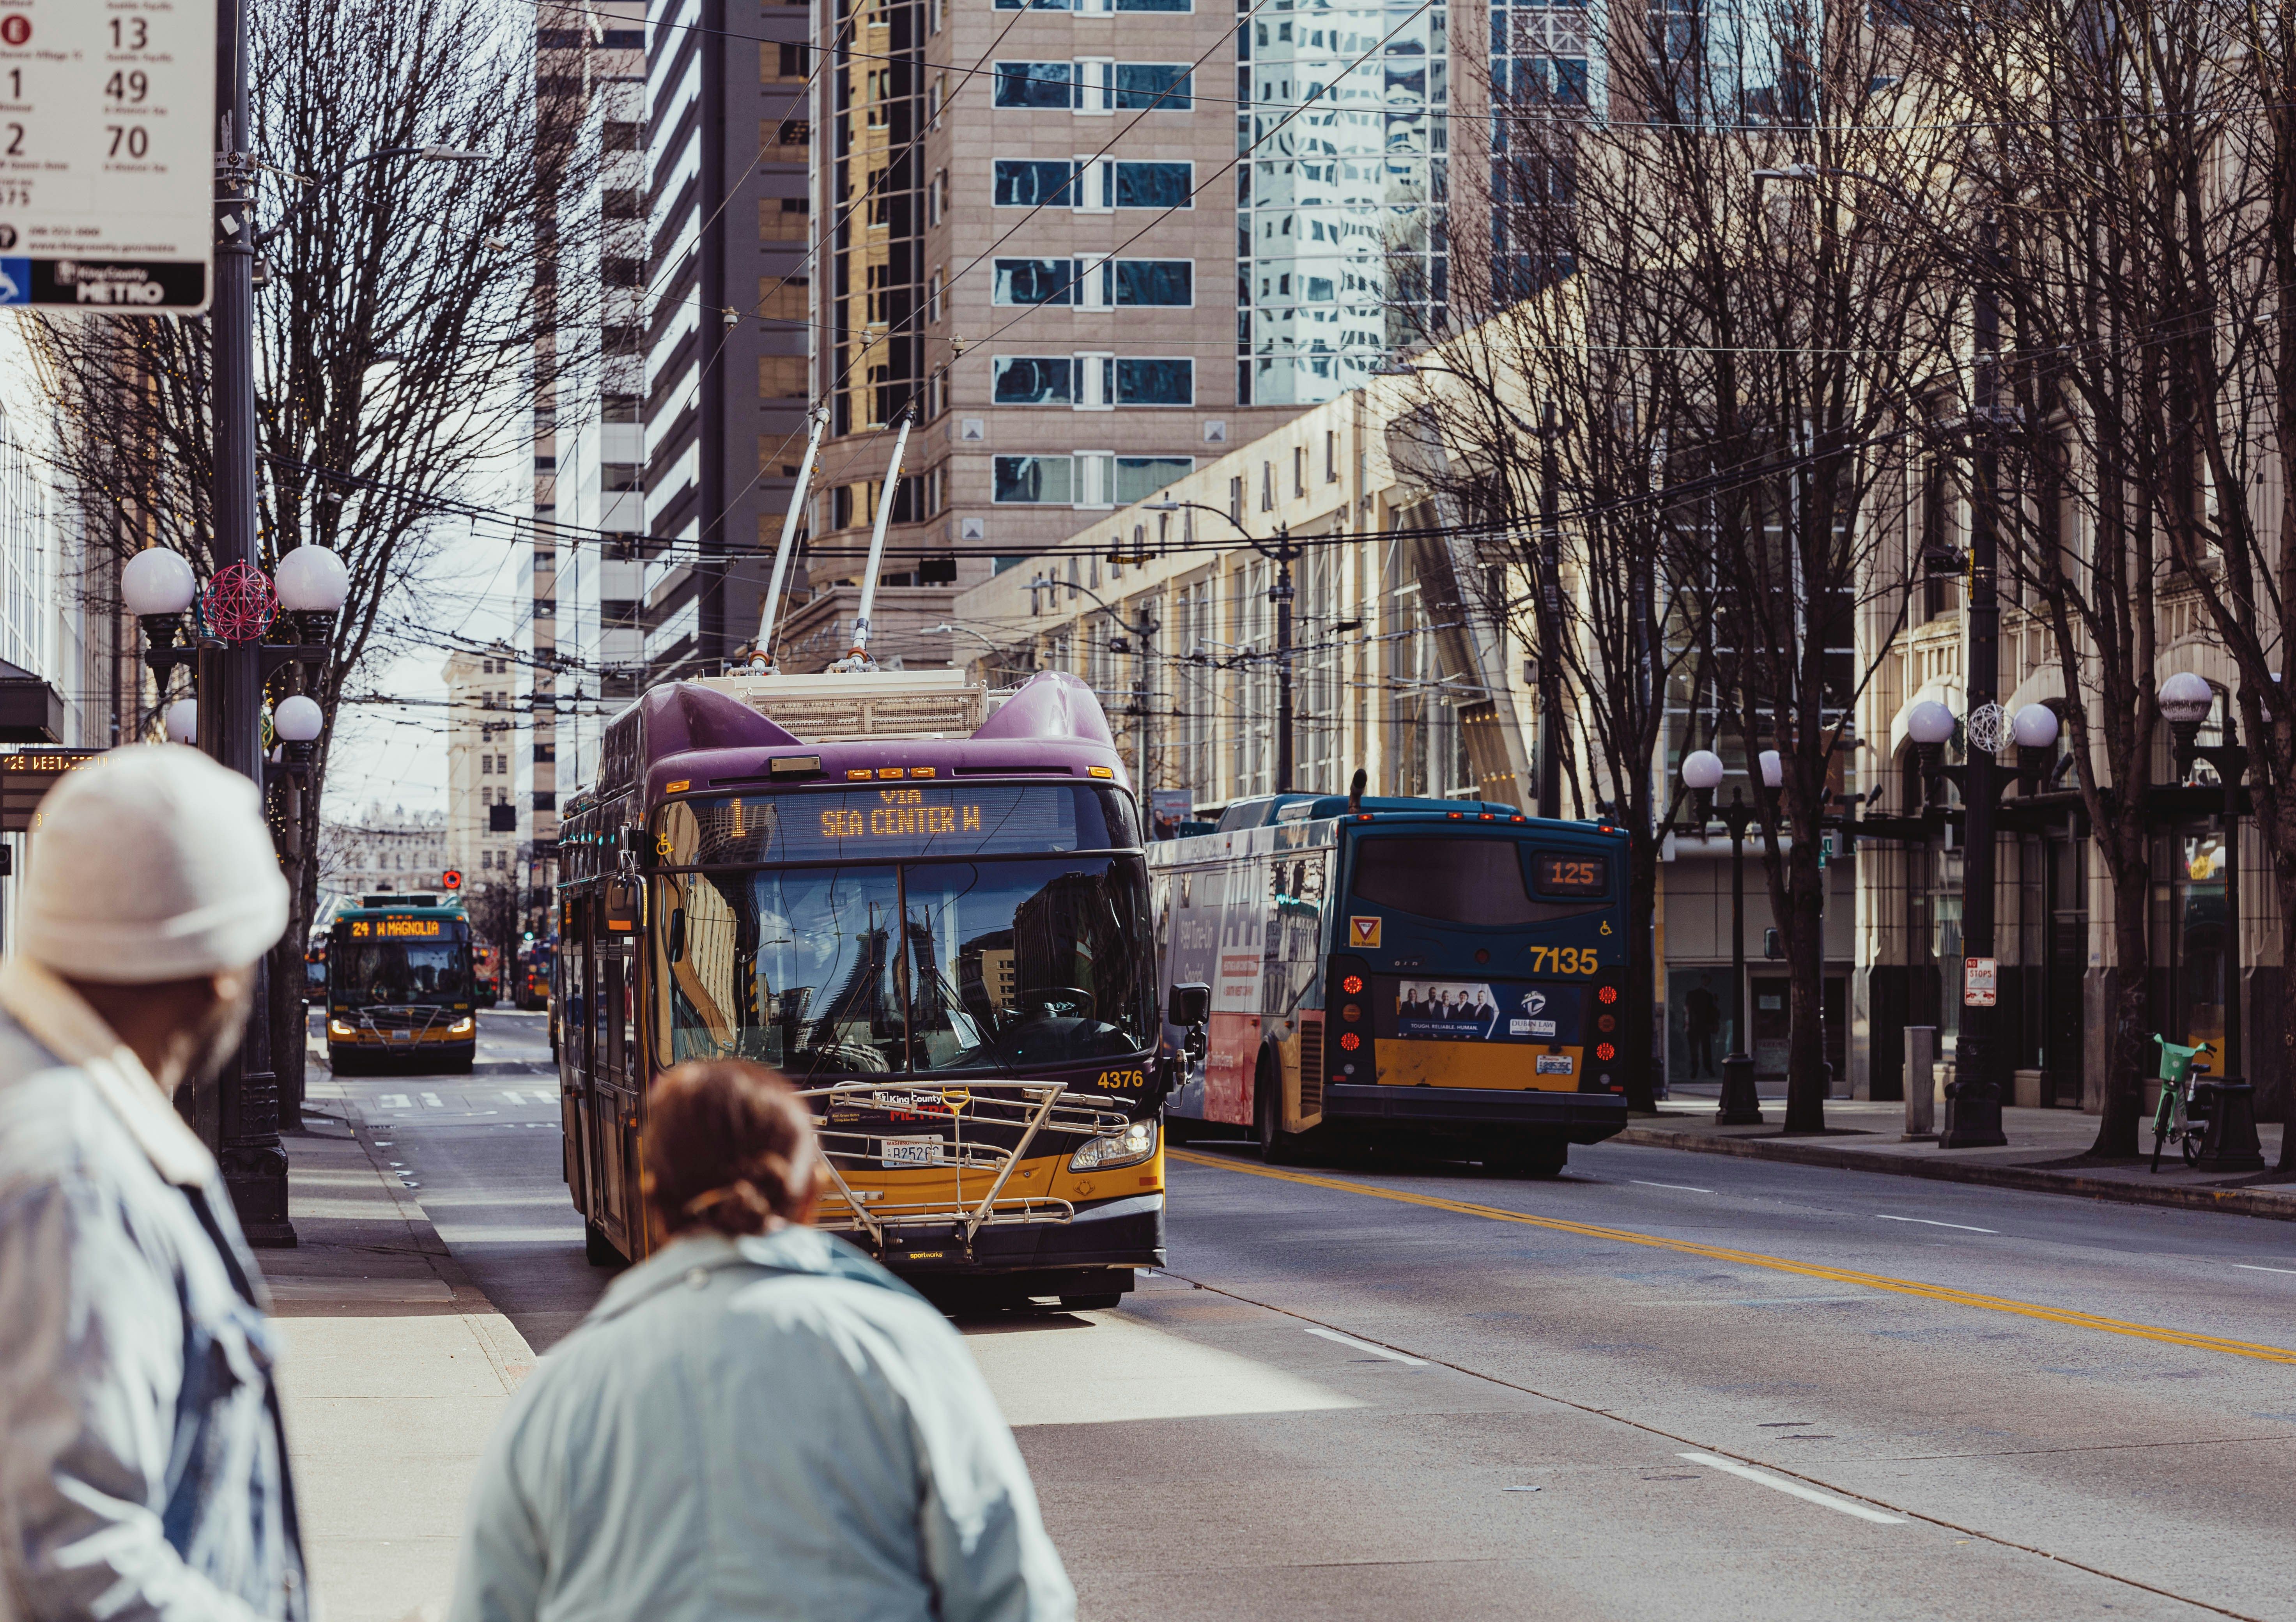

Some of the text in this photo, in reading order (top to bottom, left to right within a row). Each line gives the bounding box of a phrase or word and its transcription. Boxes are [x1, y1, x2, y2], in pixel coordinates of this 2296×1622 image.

[110, 17, 148, 50] 13
[9, 67, 21, 99] 1
[105, 70, 149, 103] 49
[7, 122, 25, 156] 2
[106, 126, 149, 159] 70
[76, 281, 165, 304] METRO
[881, 789, 921, 804] VIA
[731, 798, 745, 837] 1
[822, 806, 979, 836] SEA CENTER W
[1552, 862, 1594, 884] 125
[352, 921, 439, 937] 24 W MAGNOLIA
[1530, 946, 1598, 975] 7135
[1970, 970, 1992, 978] STOPS
[1098, 1070, 1144, 1089] 4376
[889, 1094, 942, 1104] King County
[890, 1105, 954, 1122] METRO
[910, 1251, 943, 1259] sportworks
